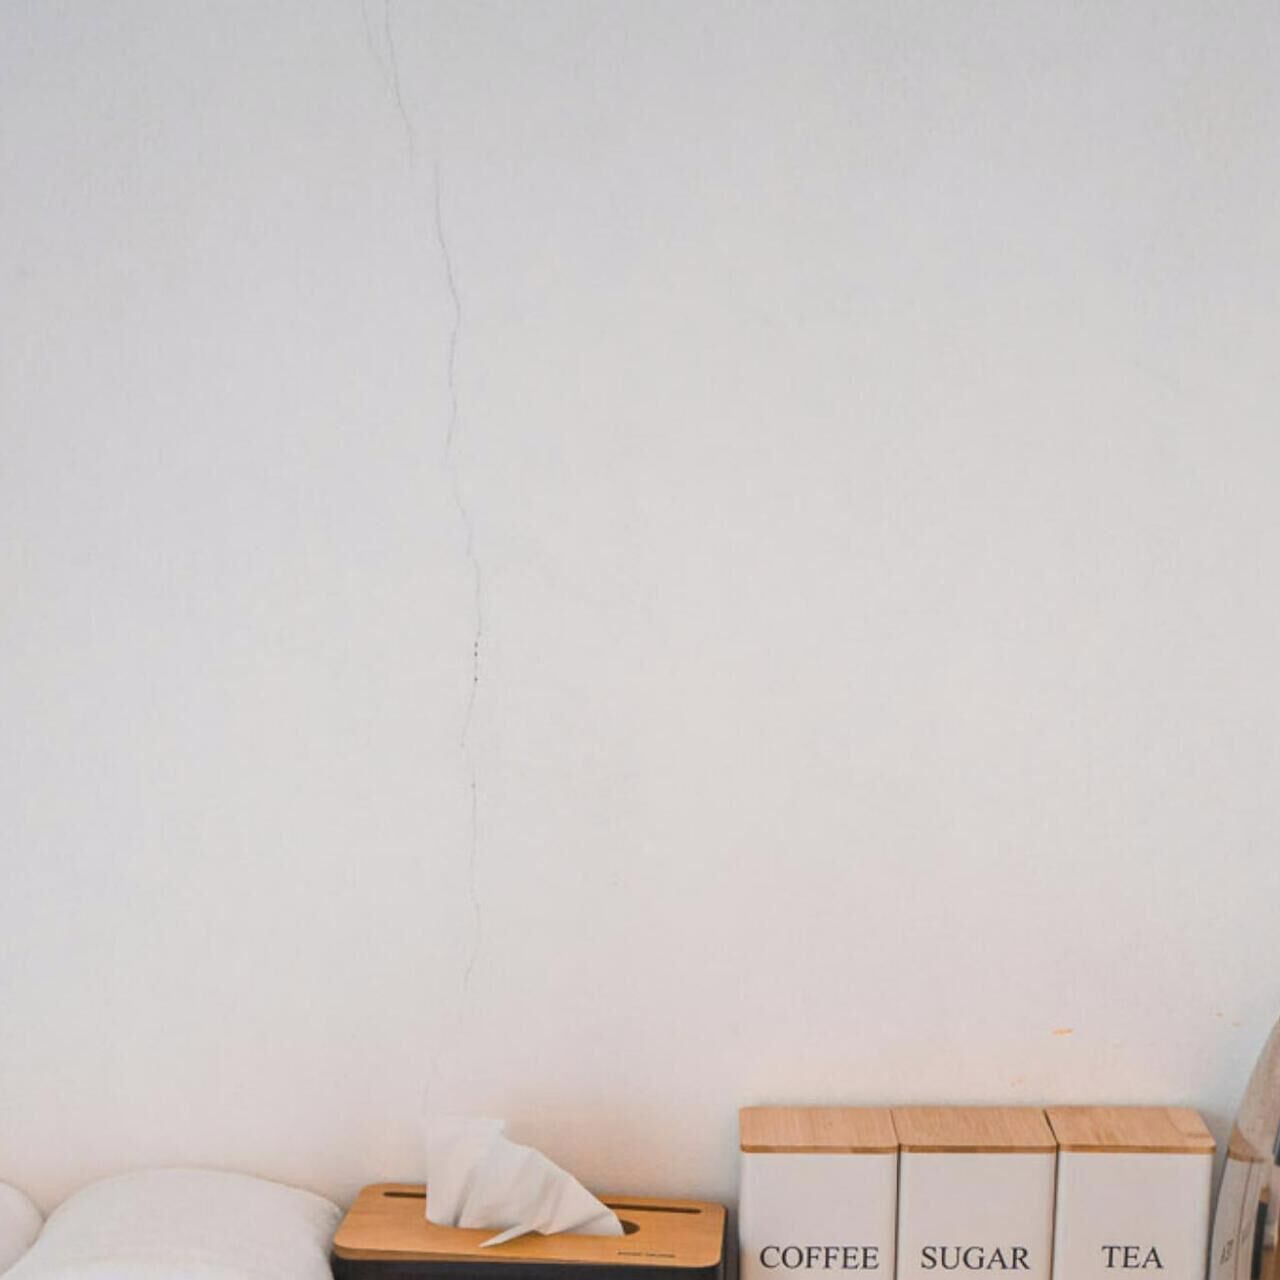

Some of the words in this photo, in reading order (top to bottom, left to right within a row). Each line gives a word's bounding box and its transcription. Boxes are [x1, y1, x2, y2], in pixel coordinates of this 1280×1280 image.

[759, 1245, 879, 1270] COFFEE
[921, 1246, 1030, 1270] SUGAR
[1101, 1245, 1163, 1269] TEA
